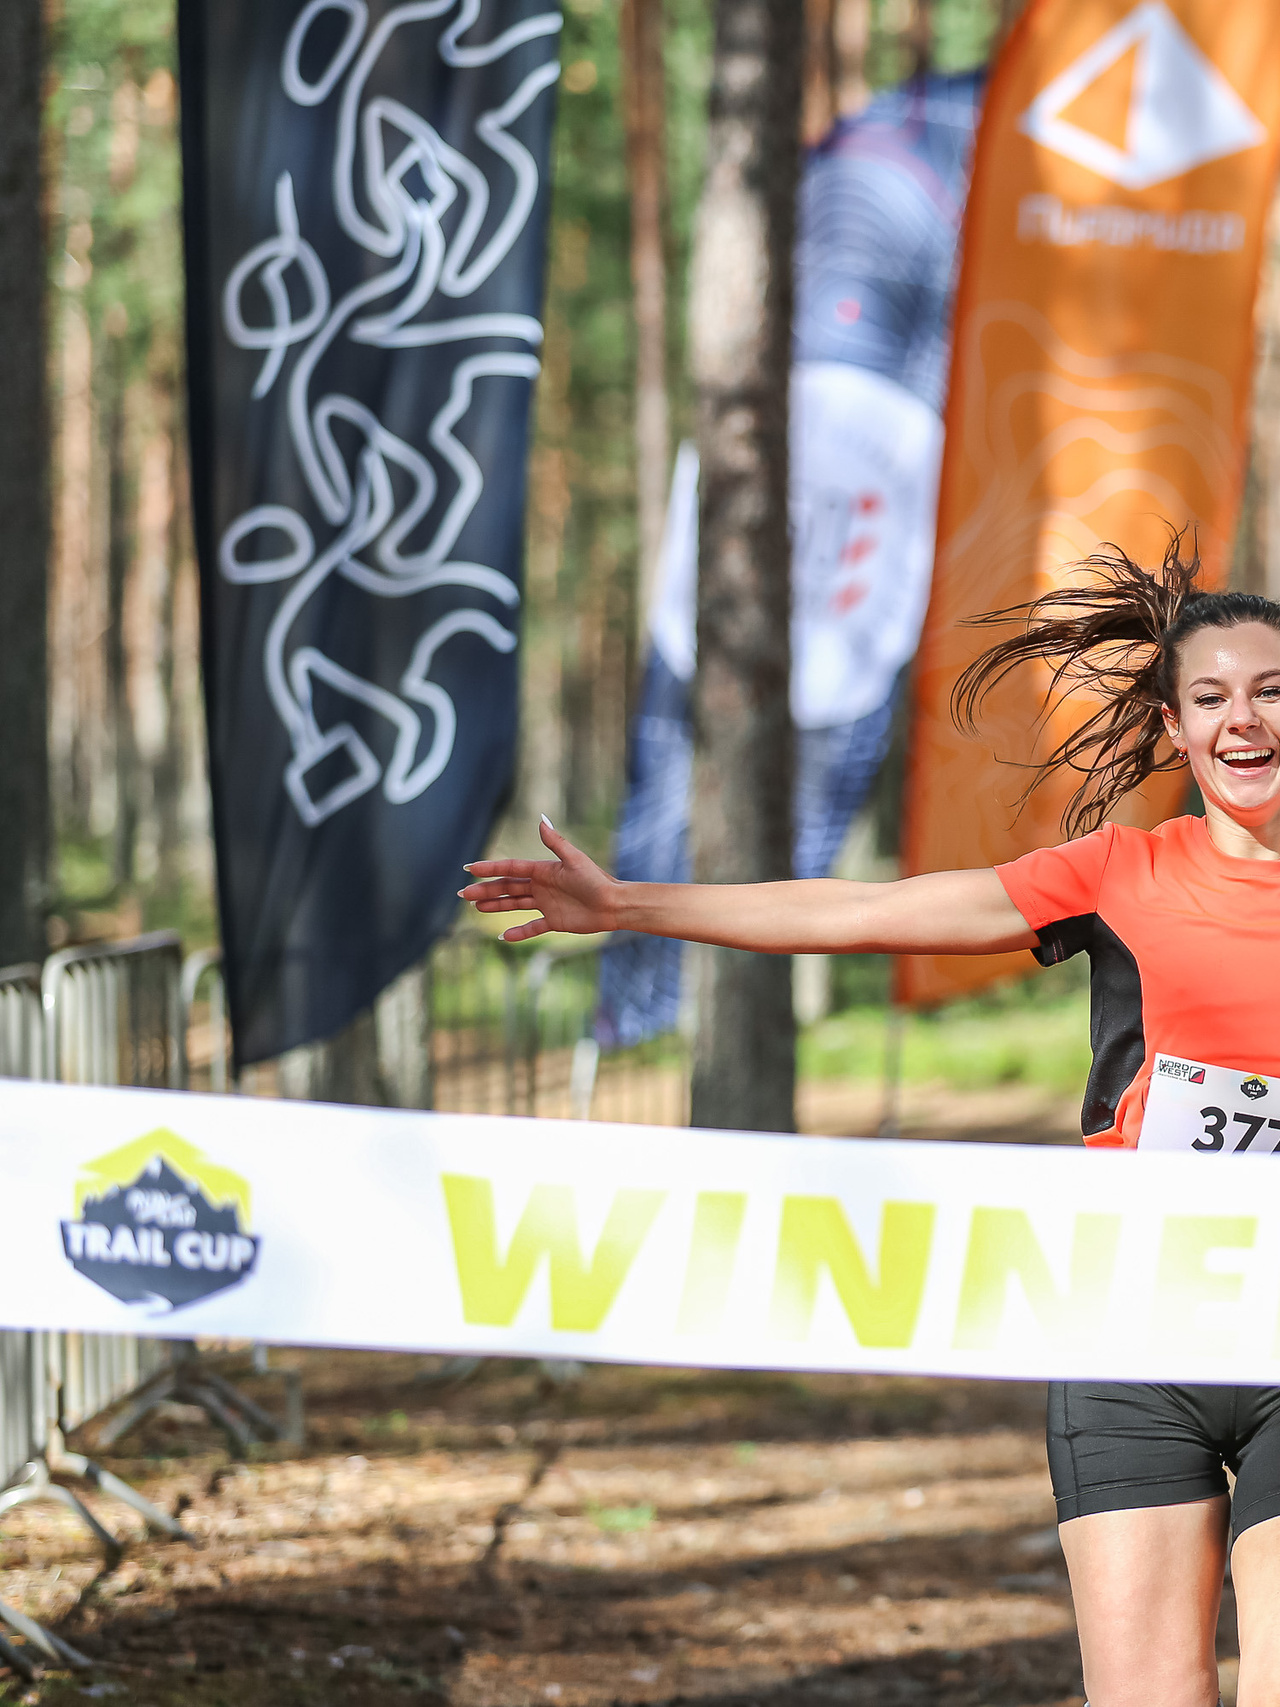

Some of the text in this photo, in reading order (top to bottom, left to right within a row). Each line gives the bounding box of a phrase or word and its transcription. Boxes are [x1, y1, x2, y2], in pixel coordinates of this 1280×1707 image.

[1159, 1059, 1189, 1071] NORD
[1159, 1066, 1188, 1078] WEST
[68, 1221, 255, 1272] TRAIL CUP
